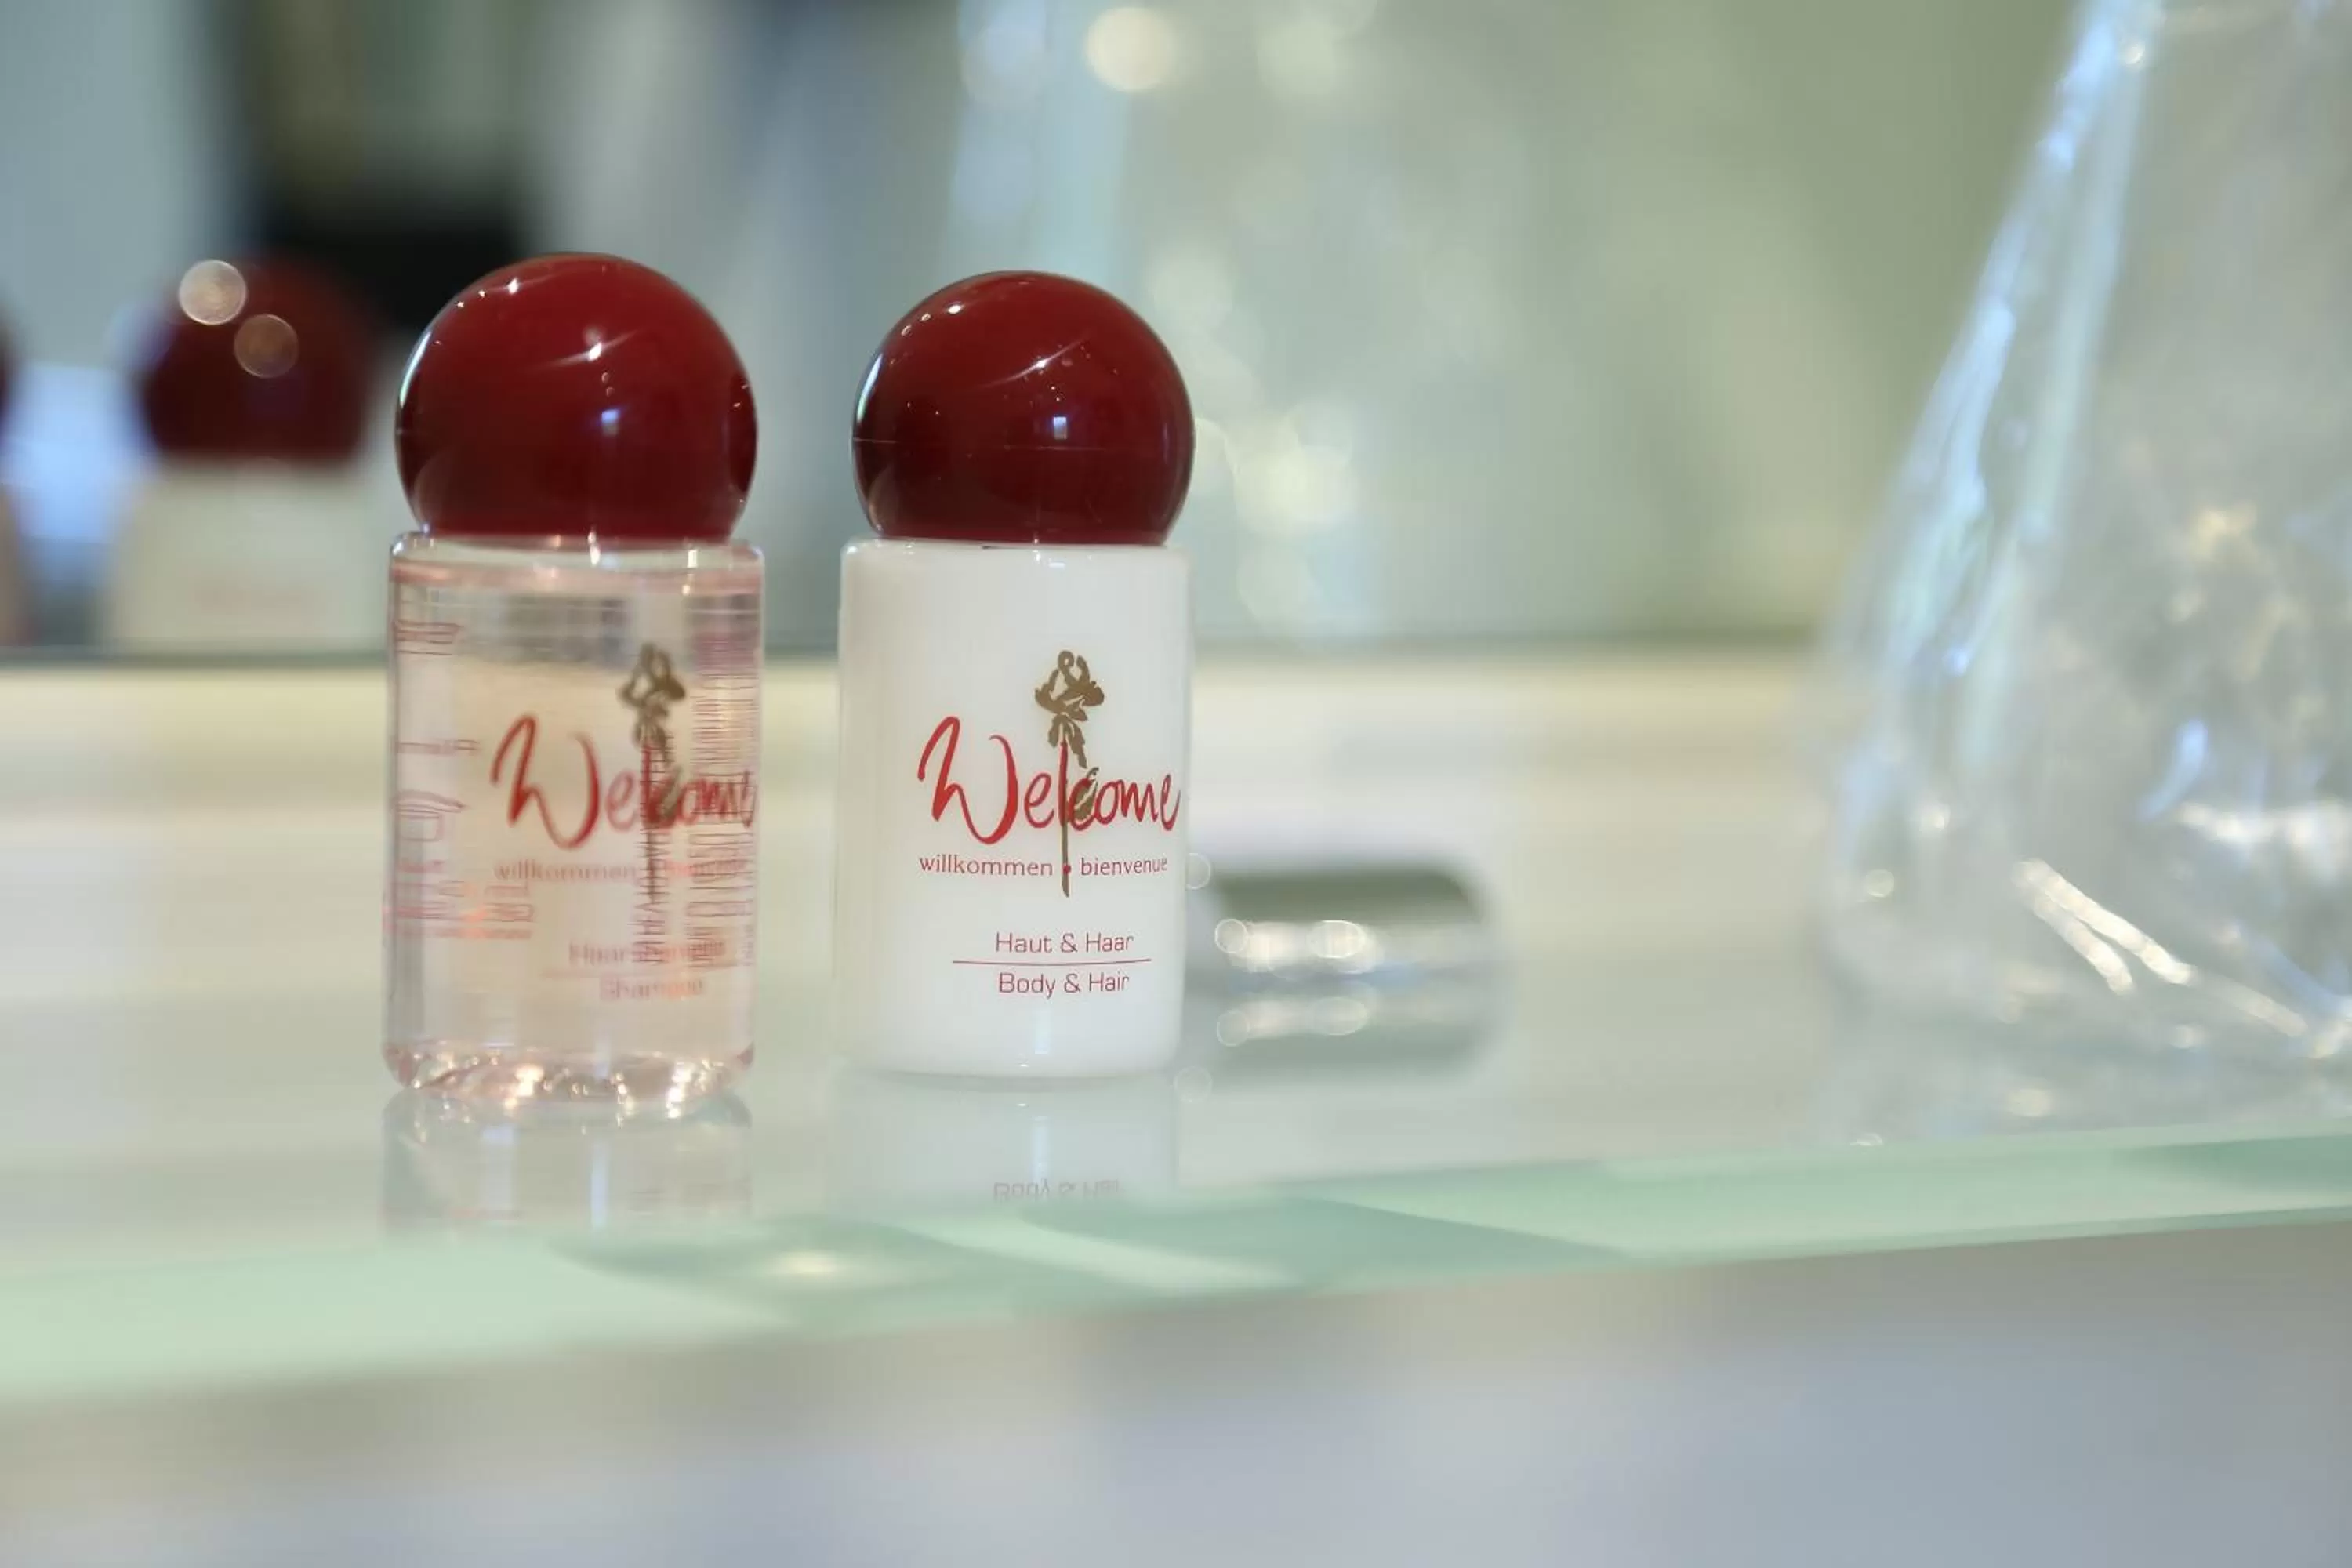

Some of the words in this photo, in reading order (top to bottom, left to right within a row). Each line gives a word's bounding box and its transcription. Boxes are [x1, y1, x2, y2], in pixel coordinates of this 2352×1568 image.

[492, 714, 756, 848] Welcome
[917, 716, 1181, 845] Welcome
[919, 855, 1053, 877] willkommen
[1080, 858, 1168, 877] bienvenue
[995, 932, 1053, 954] Haut
[1060, 933, 1079, 954] &
[1086, 931, 1134, 953] Haar
[999, 972, 1057, 1000] Body
[1064, 973, 1082, 994] &
[1088, 972, 1130, 993] Hair
